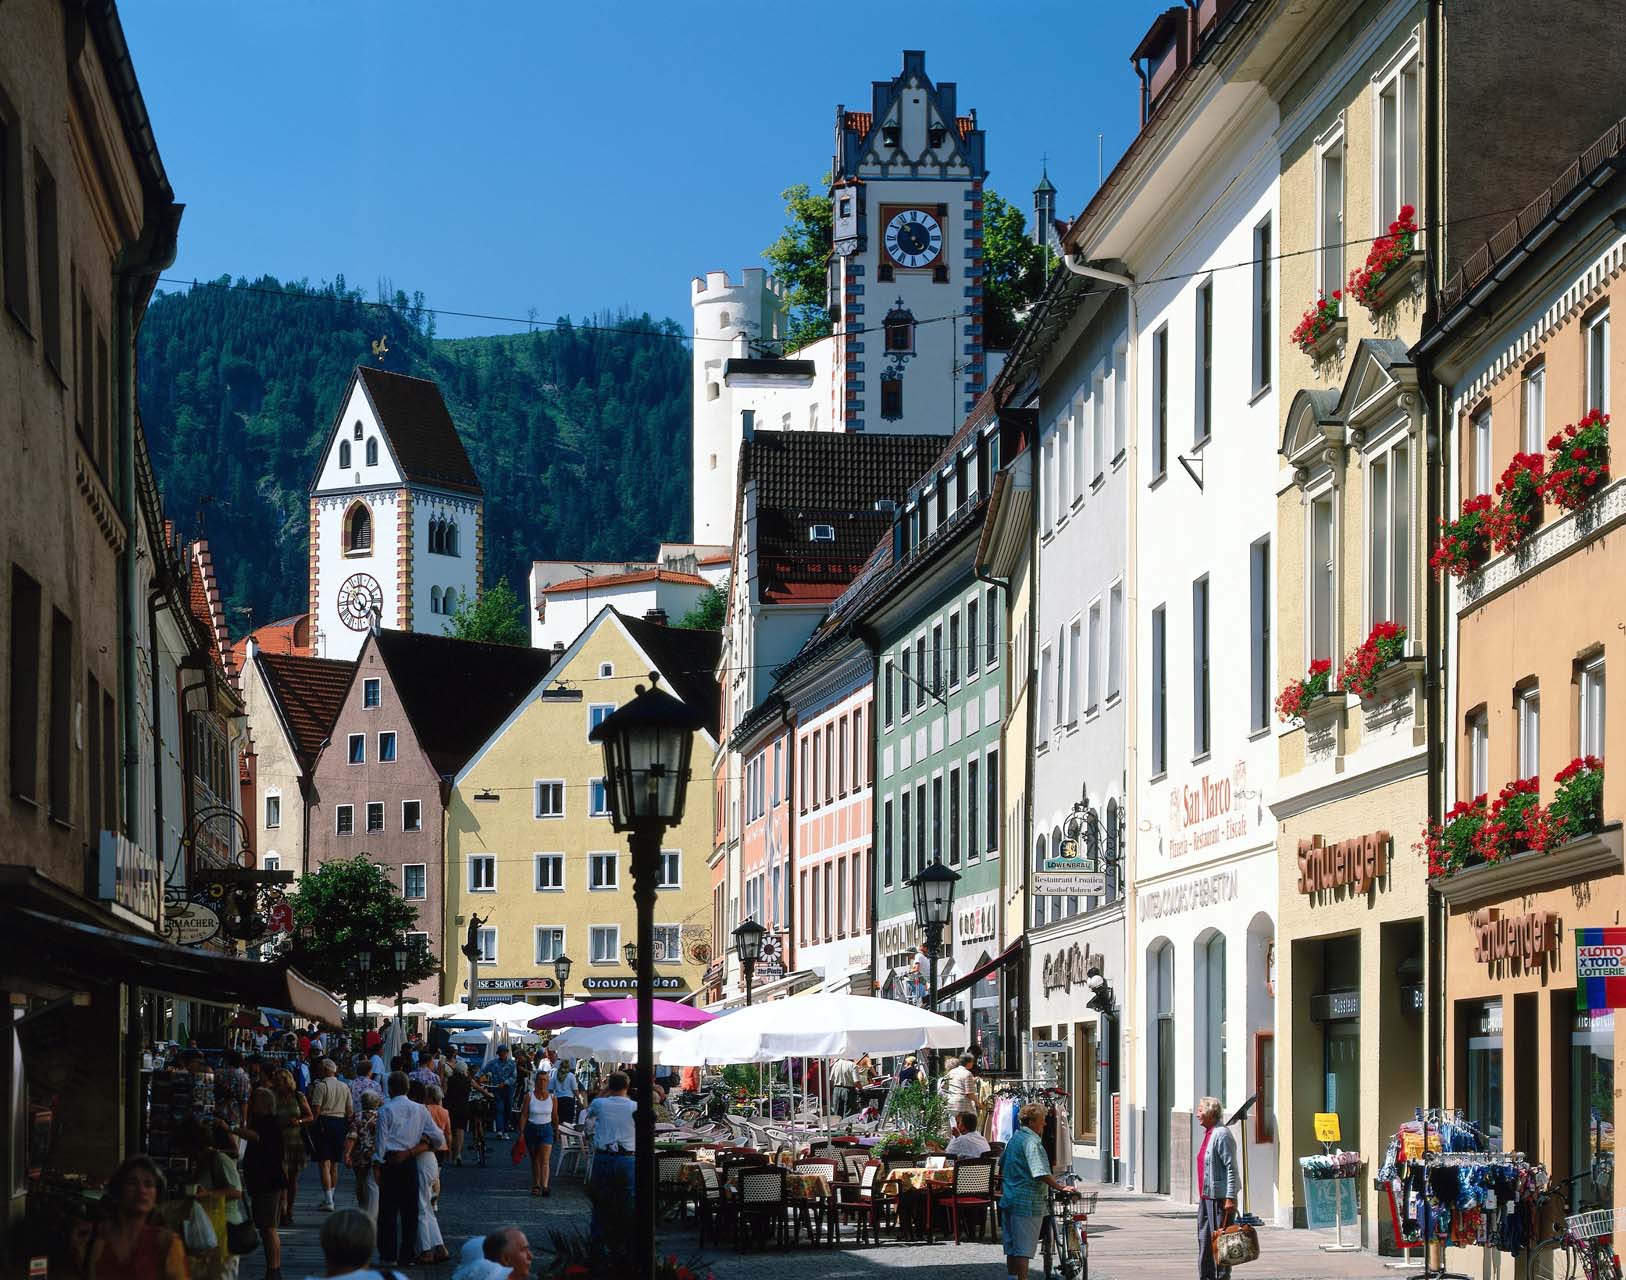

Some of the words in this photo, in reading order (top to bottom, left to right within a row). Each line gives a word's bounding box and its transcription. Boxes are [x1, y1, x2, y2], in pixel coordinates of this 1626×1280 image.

[1183, 784, 1200, 828] San
[1201, 776, 1231, 821] Marco
[1298, 829, 1390, 894] Schwenger
[1035, 875, 1072, 883] Restaurant
[1474, 909, 1558, 968] Schwenger
[1587, 946, 1624, 957] LOTTO
[1589, 957, 1620, 967] TOTO
[1578, 967, 1626, 977] LOTTERIE
[588, 978, 627, 988] braun
[630, 977, 679, 988] mden
